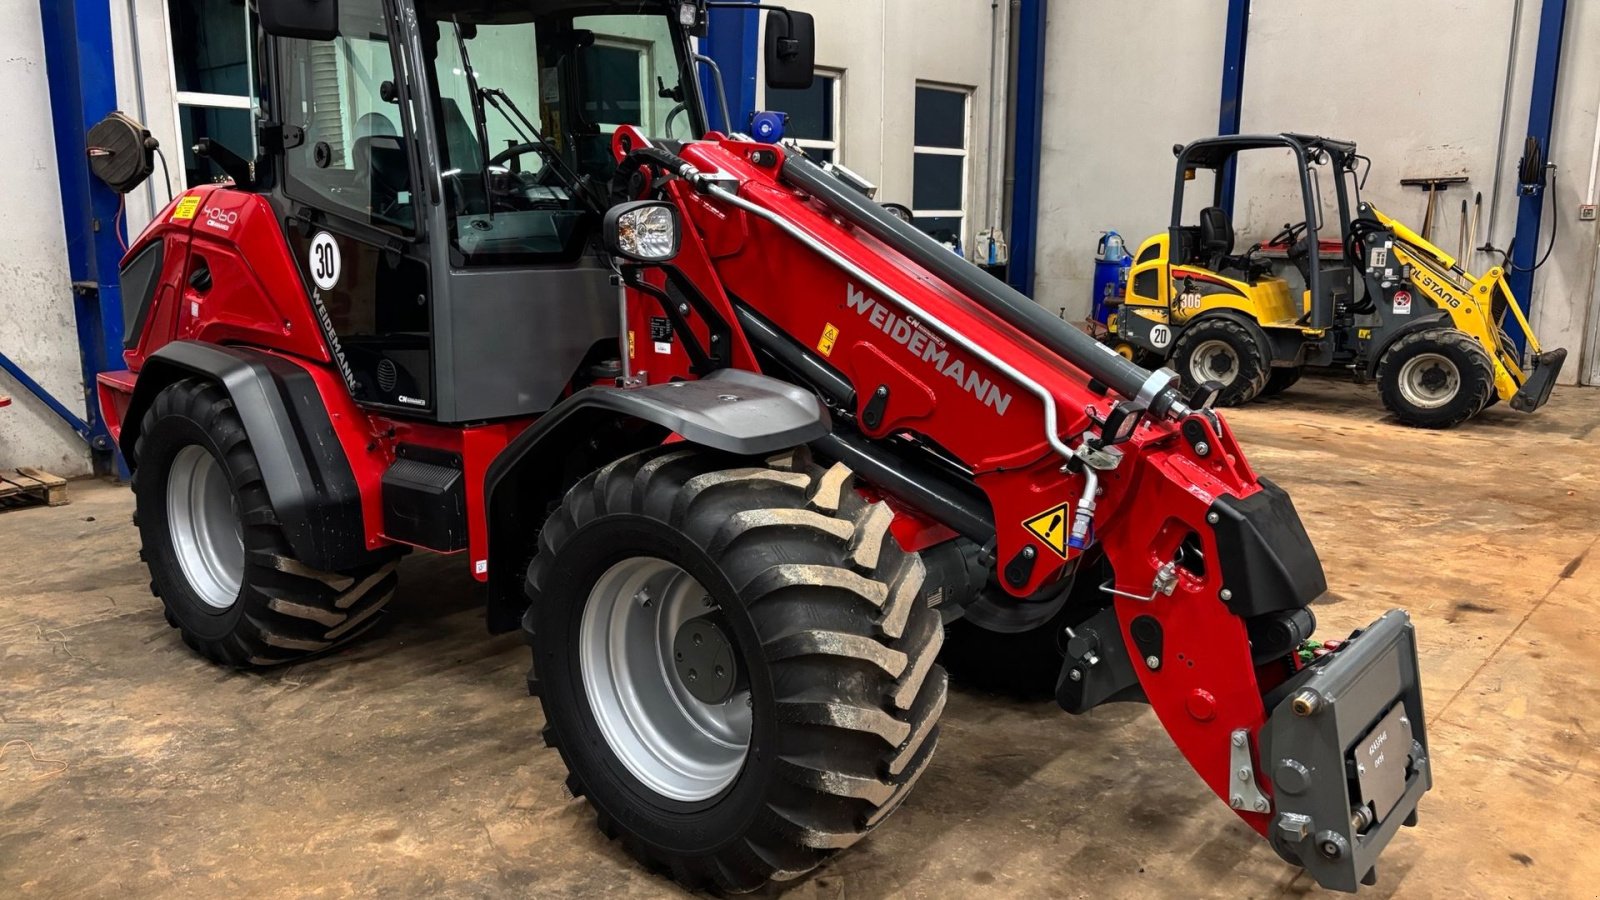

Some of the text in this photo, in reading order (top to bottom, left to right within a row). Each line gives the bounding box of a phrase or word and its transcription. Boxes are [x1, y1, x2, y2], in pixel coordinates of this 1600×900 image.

[204, 205, 238, 224] 4060
[315, 242, 334, 279] 30
[1181, 293, 1201, 309] 306
[312, 286, 356, 388] WEIDEMANN
[846, 282, 1013, 416] WEIDEMANN
[1154, 328, 1167, 344] 20
